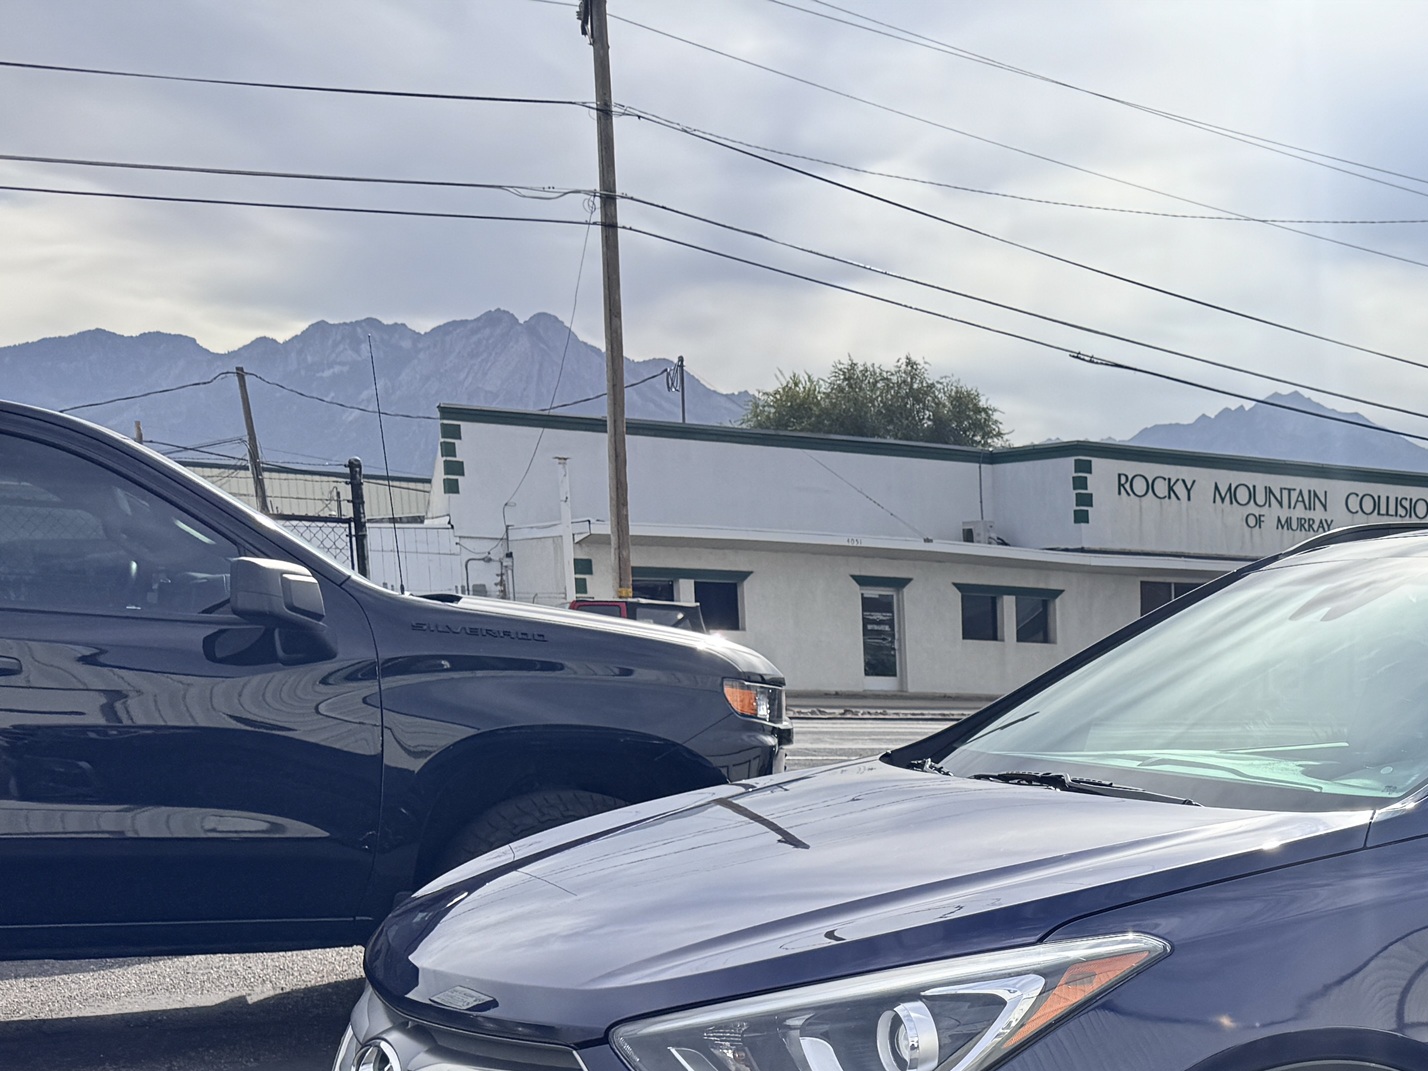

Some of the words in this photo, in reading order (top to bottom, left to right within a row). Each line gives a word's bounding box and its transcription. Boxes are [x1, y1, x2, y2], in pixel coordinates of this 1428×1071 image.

[1117, 472, 1196, 502] ROCKY
[1212, 481, 1328, 512] MOUNTAIN
[1245, 512, 1265, 529] OF
[1276, 515, 1334, 533] MURRAY
[411, 622, 547, 642] SILVERADO
